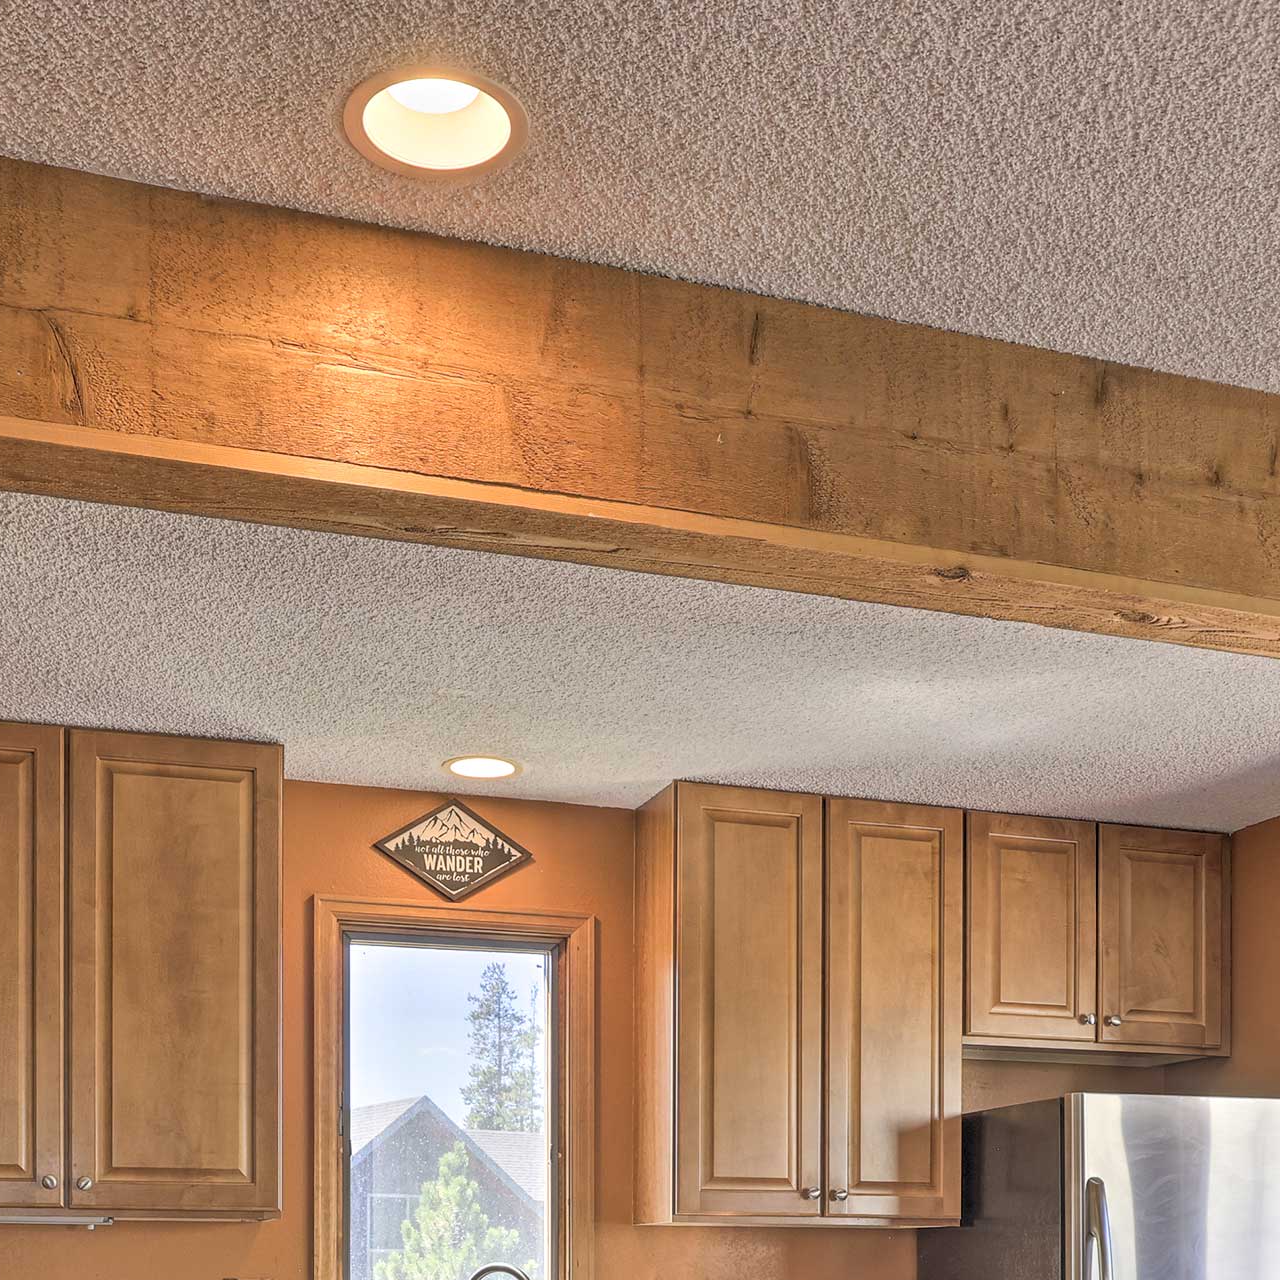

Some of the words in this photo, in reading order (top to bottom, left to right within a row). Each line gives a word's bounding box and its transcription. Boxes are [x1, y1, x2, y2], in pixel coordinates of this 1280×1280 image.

[415, 845, 429, 853] not
[431, 844, 445, 854] all
[445, 845, 470, 856] those
[471, 846, 490, 857] who
[423, 853, 483, 873] WANDER
[436, 873, 452, 881] are
[452, 872, 471, 883] lost
